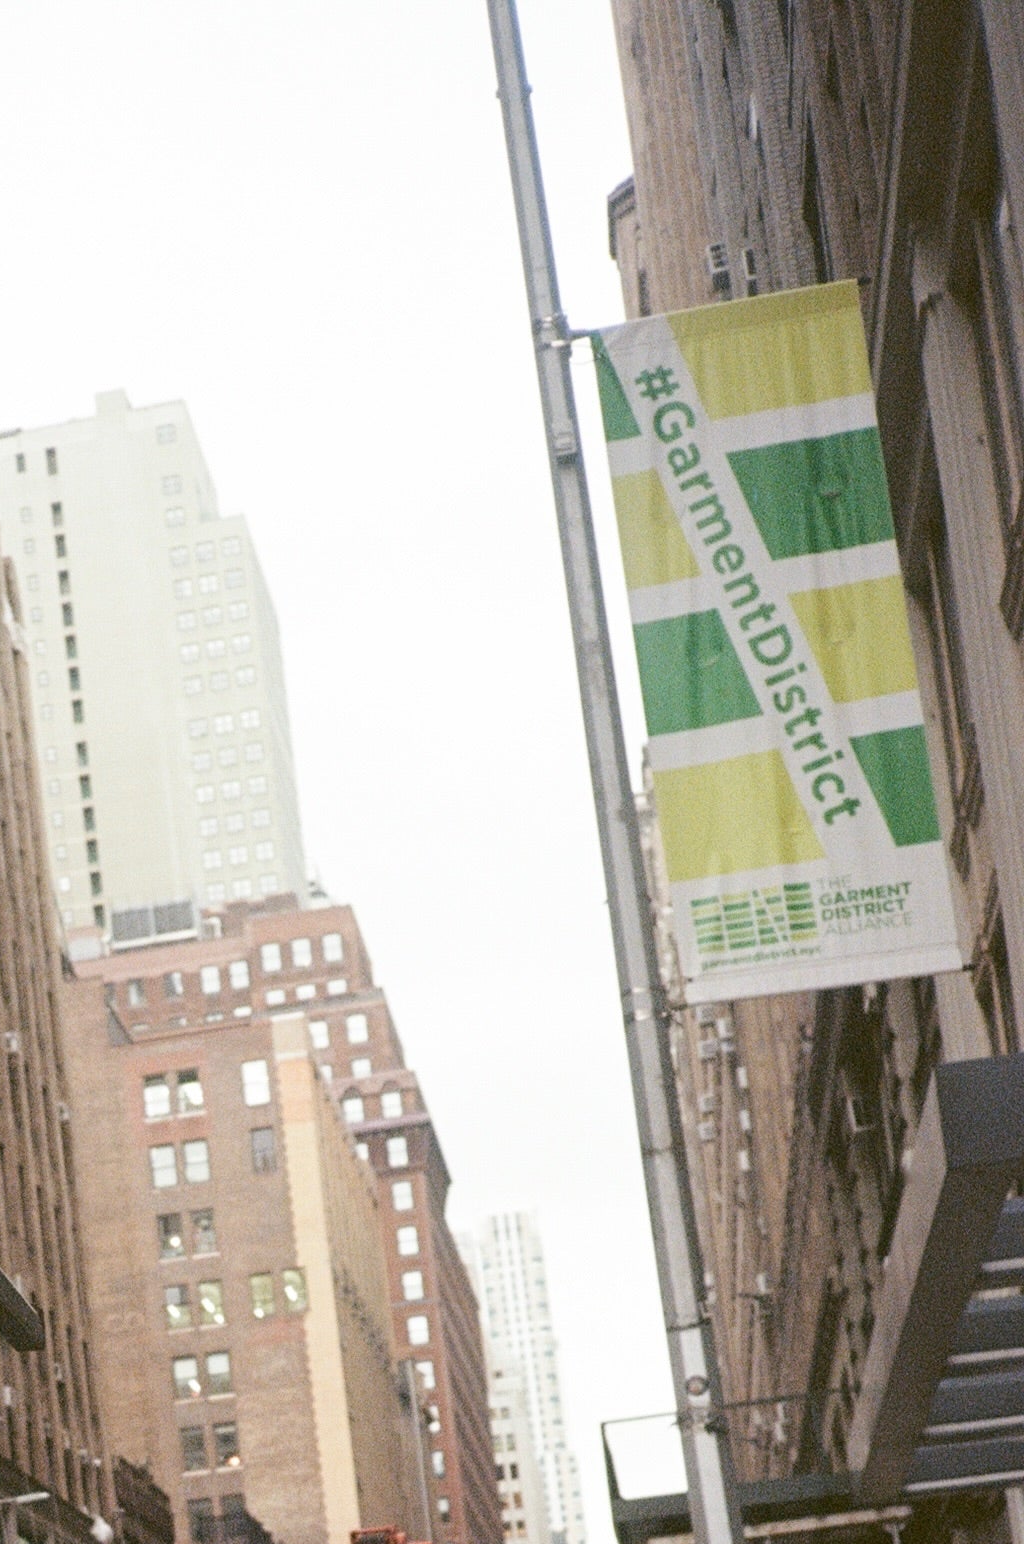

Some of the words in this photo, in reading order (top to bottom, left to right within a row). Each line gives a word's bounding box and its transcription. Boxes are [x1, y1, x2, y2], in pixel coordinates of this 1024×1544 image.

[635, 364, 861, 826] #GarmentDistrict
[816, 874, 852, 889] THE
[819, 881, 912, 907] GARMENT
[821, 898, 906, 922] DISTRICT
[825, 911, 913, 936] ALLIANCE
